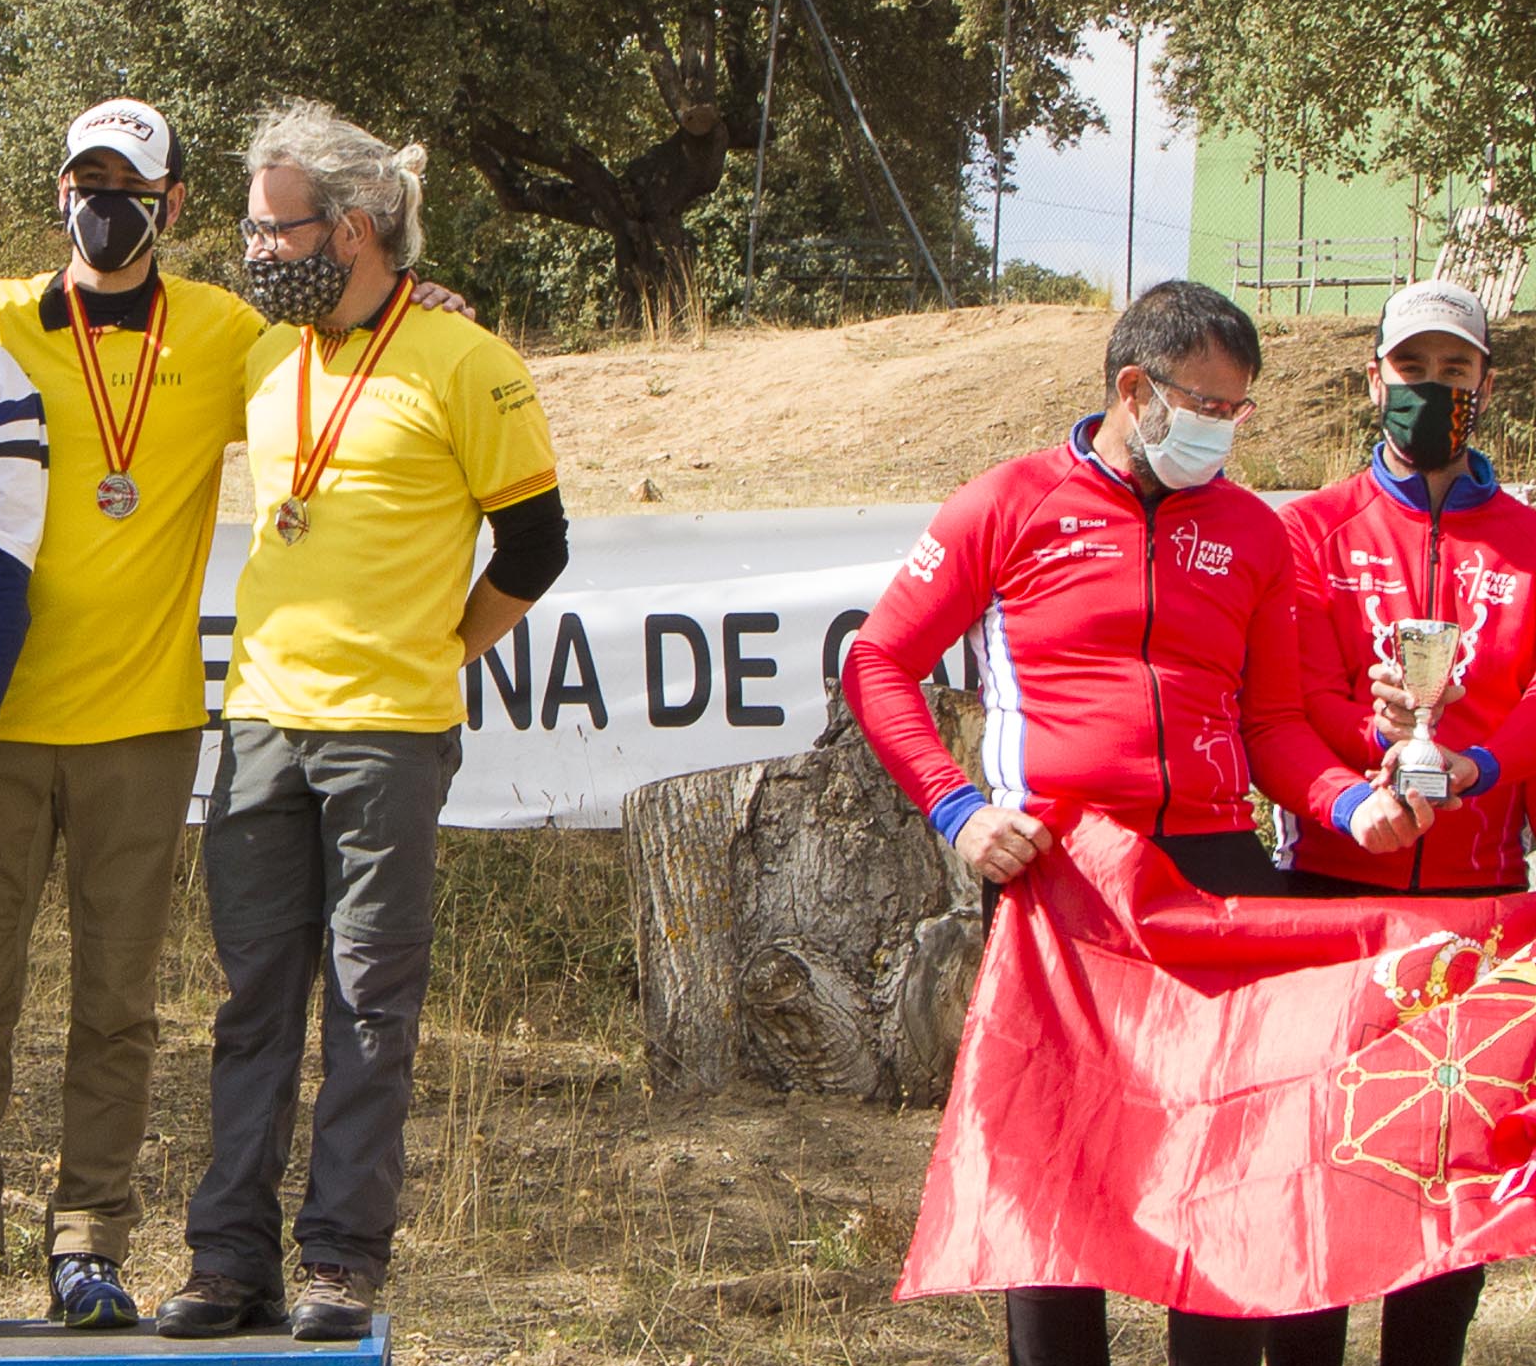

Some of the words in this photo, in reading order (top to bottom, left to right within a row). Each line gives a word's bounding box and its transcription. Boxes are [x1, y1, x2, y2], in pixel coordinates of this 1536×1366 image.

[1199, 540, 1233, 557] FNTA
[1483, 569, 1517, 586] FNTA
[645, 610, 786, 729] DE
